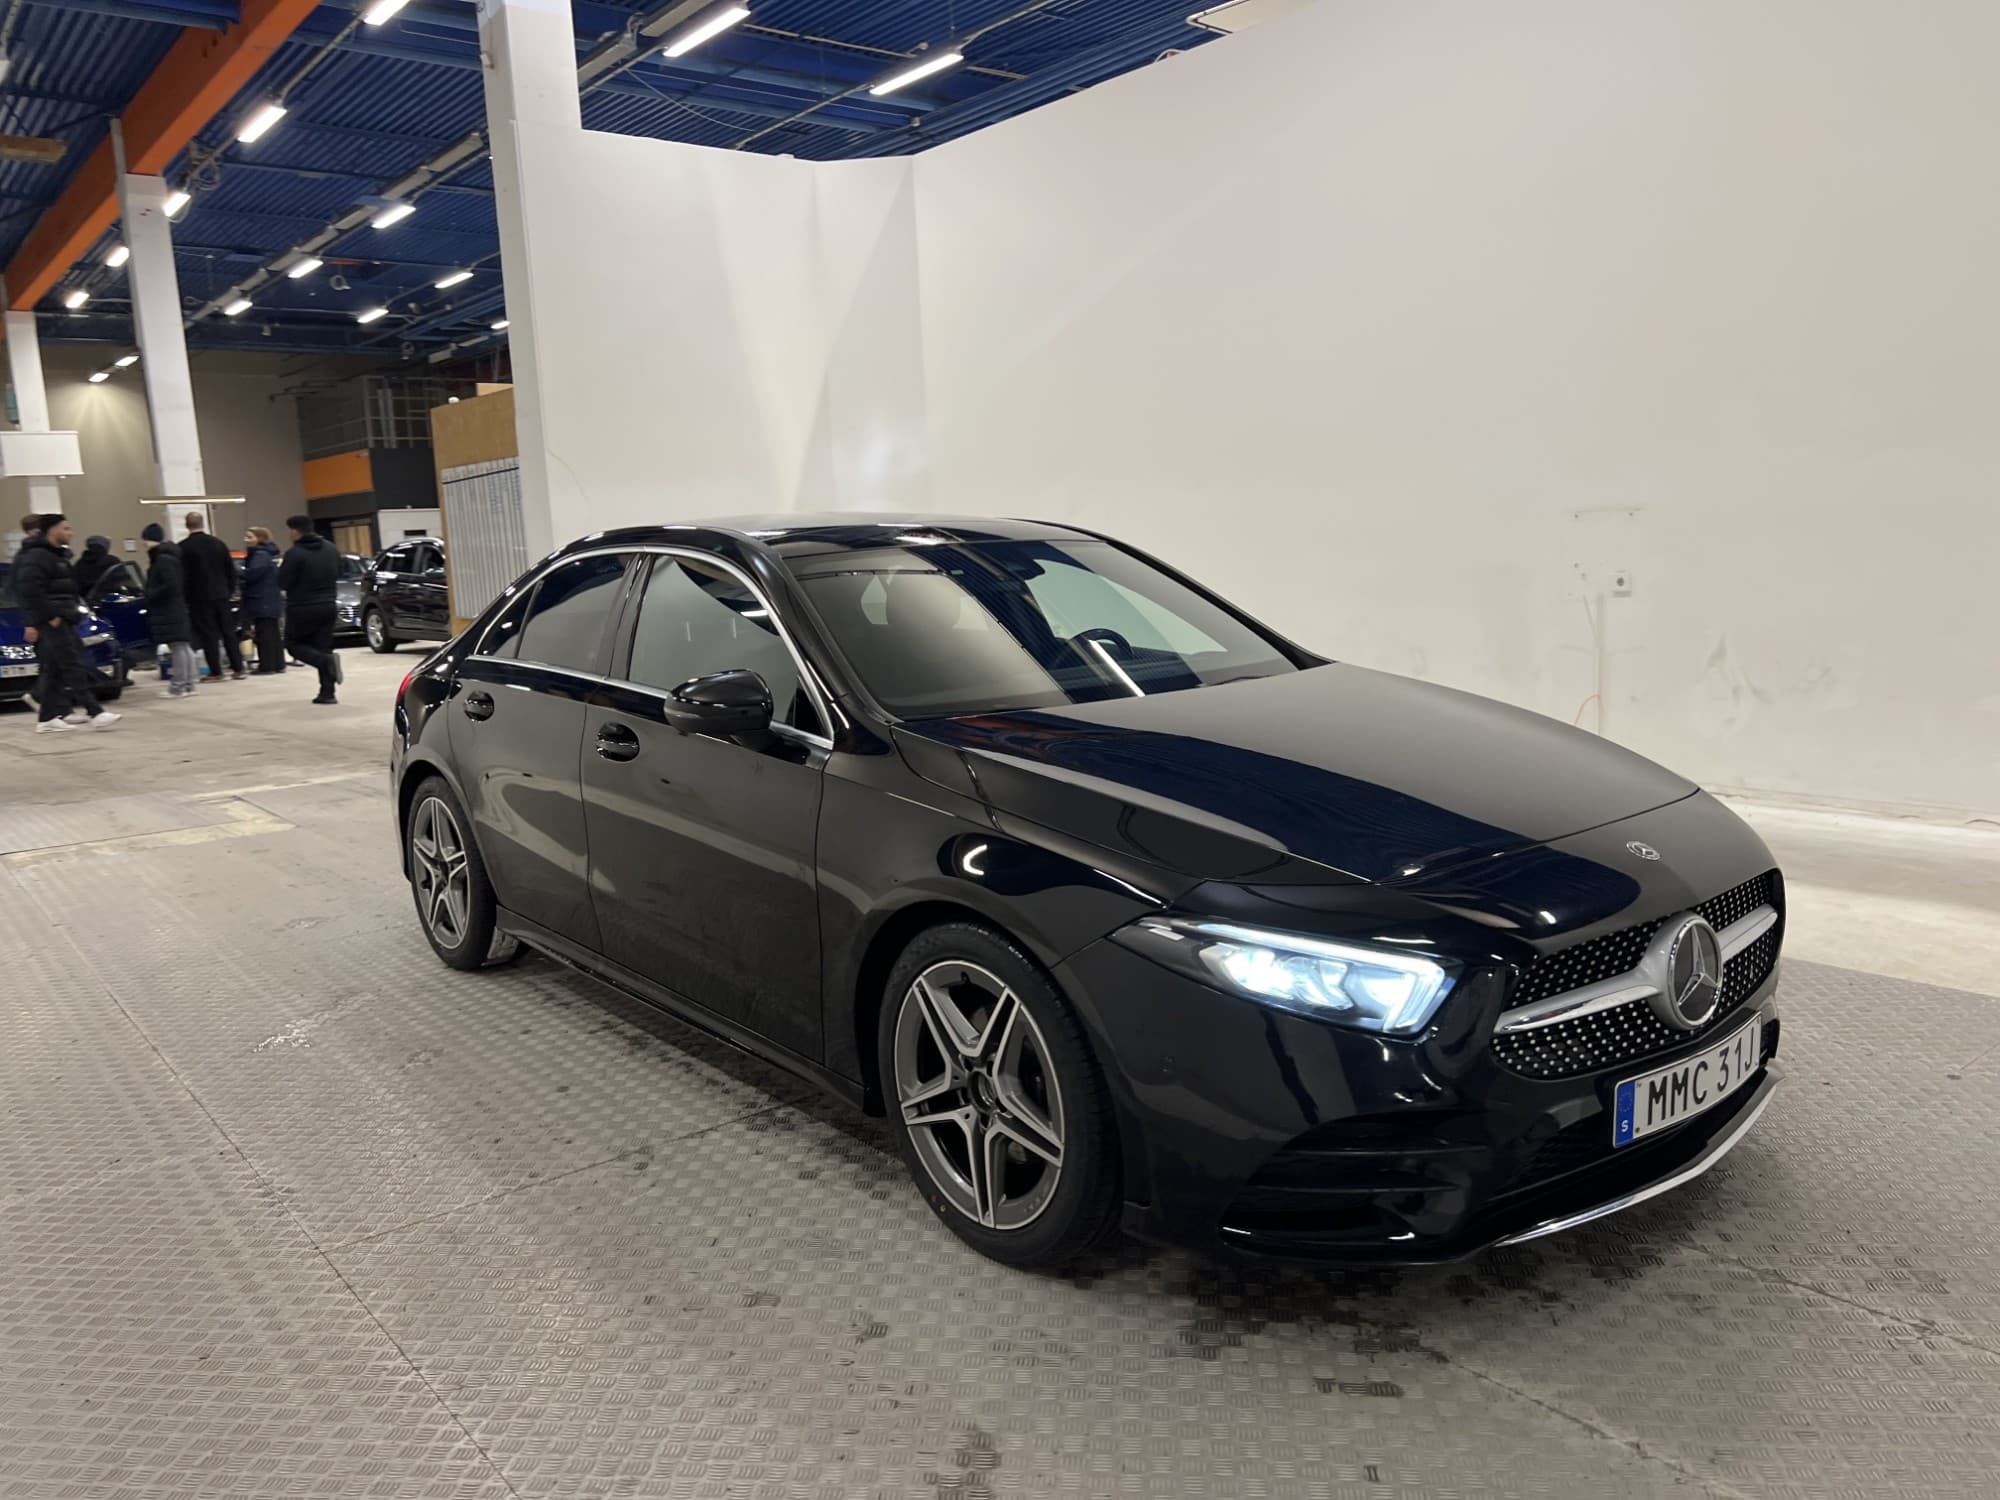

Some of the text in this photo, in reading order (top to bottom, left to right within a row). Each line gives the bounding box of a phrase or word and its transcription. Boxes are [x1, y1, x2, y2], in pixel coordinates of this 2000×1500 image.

[1648, 1027, 1754, 1125] MMC 31J
[1621, 1120, 1629, 1132] S
